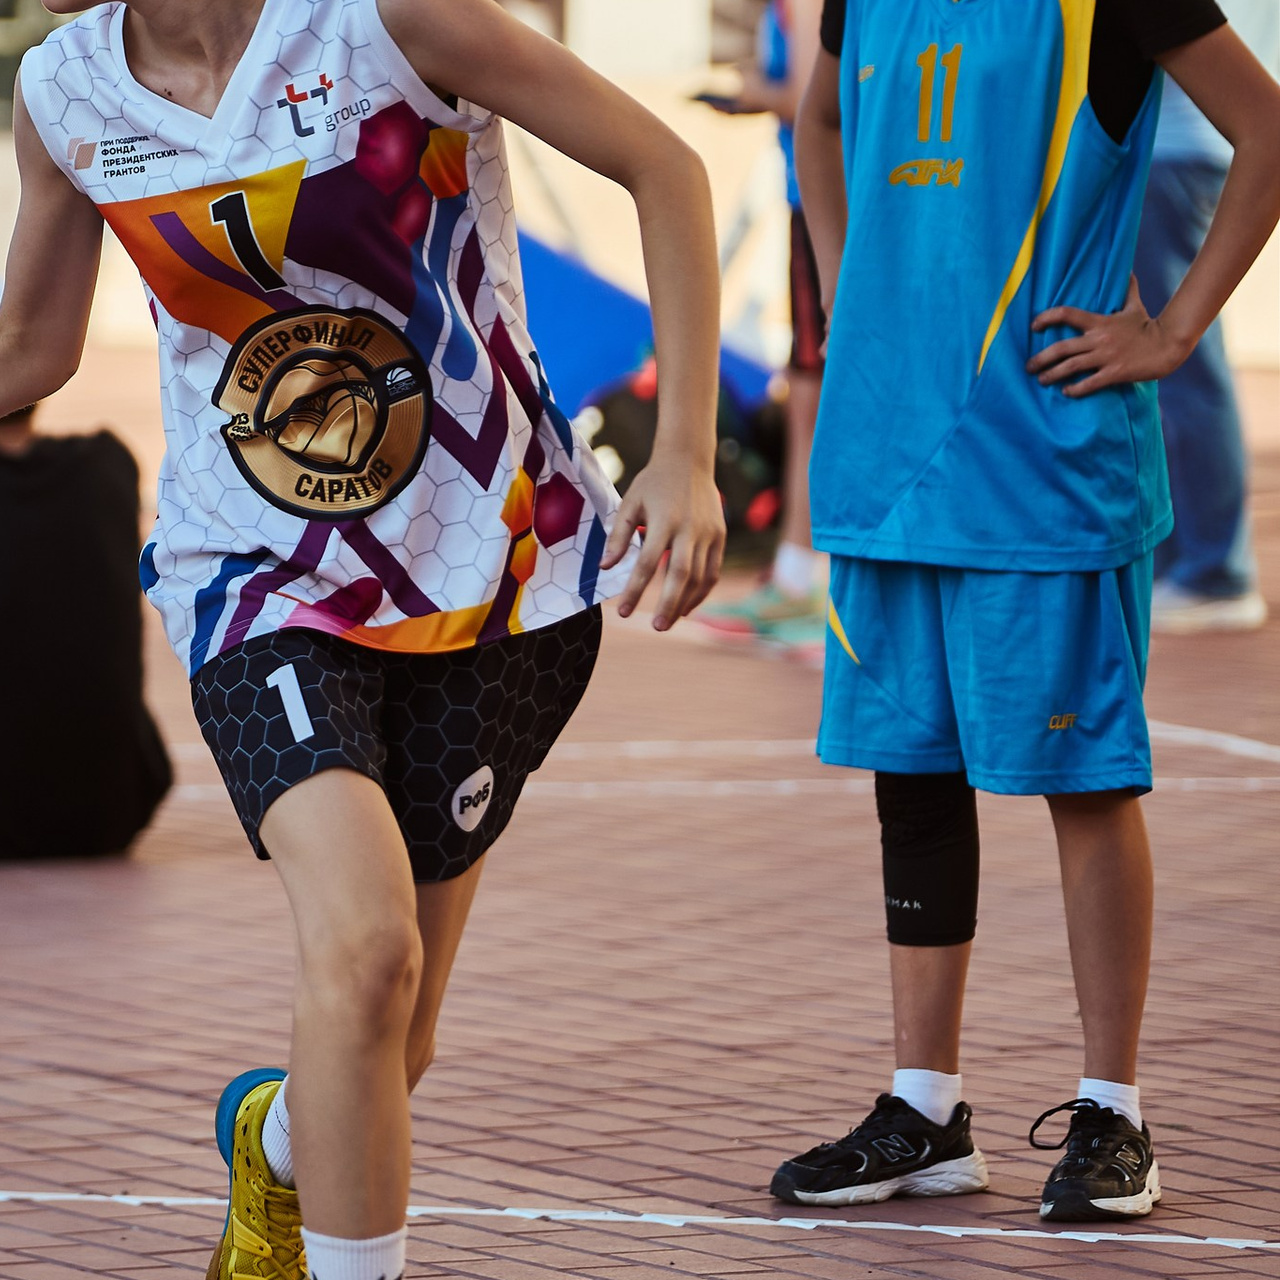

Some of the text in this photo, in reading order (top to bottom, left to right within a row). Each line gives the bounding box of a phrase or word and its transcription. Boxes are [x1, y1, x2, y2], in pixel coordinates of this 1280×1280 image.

[324, 98, 371, 132] group
[916, 42, 963, 143] 11
[101, 144, 137, 156] ФОНДА
[103, 149, 179, 168] ПРЕЗИДЕНТСКИХ
[104, 165, 146, 179] ГРАНТОВ
[210, 190, 288, 292] 1
[238, 321, 375, 394] СУПЕРФИНАЛ
[294, 457, 393, 503] САРАТОВ
[266, 662, 315, 743] 1
